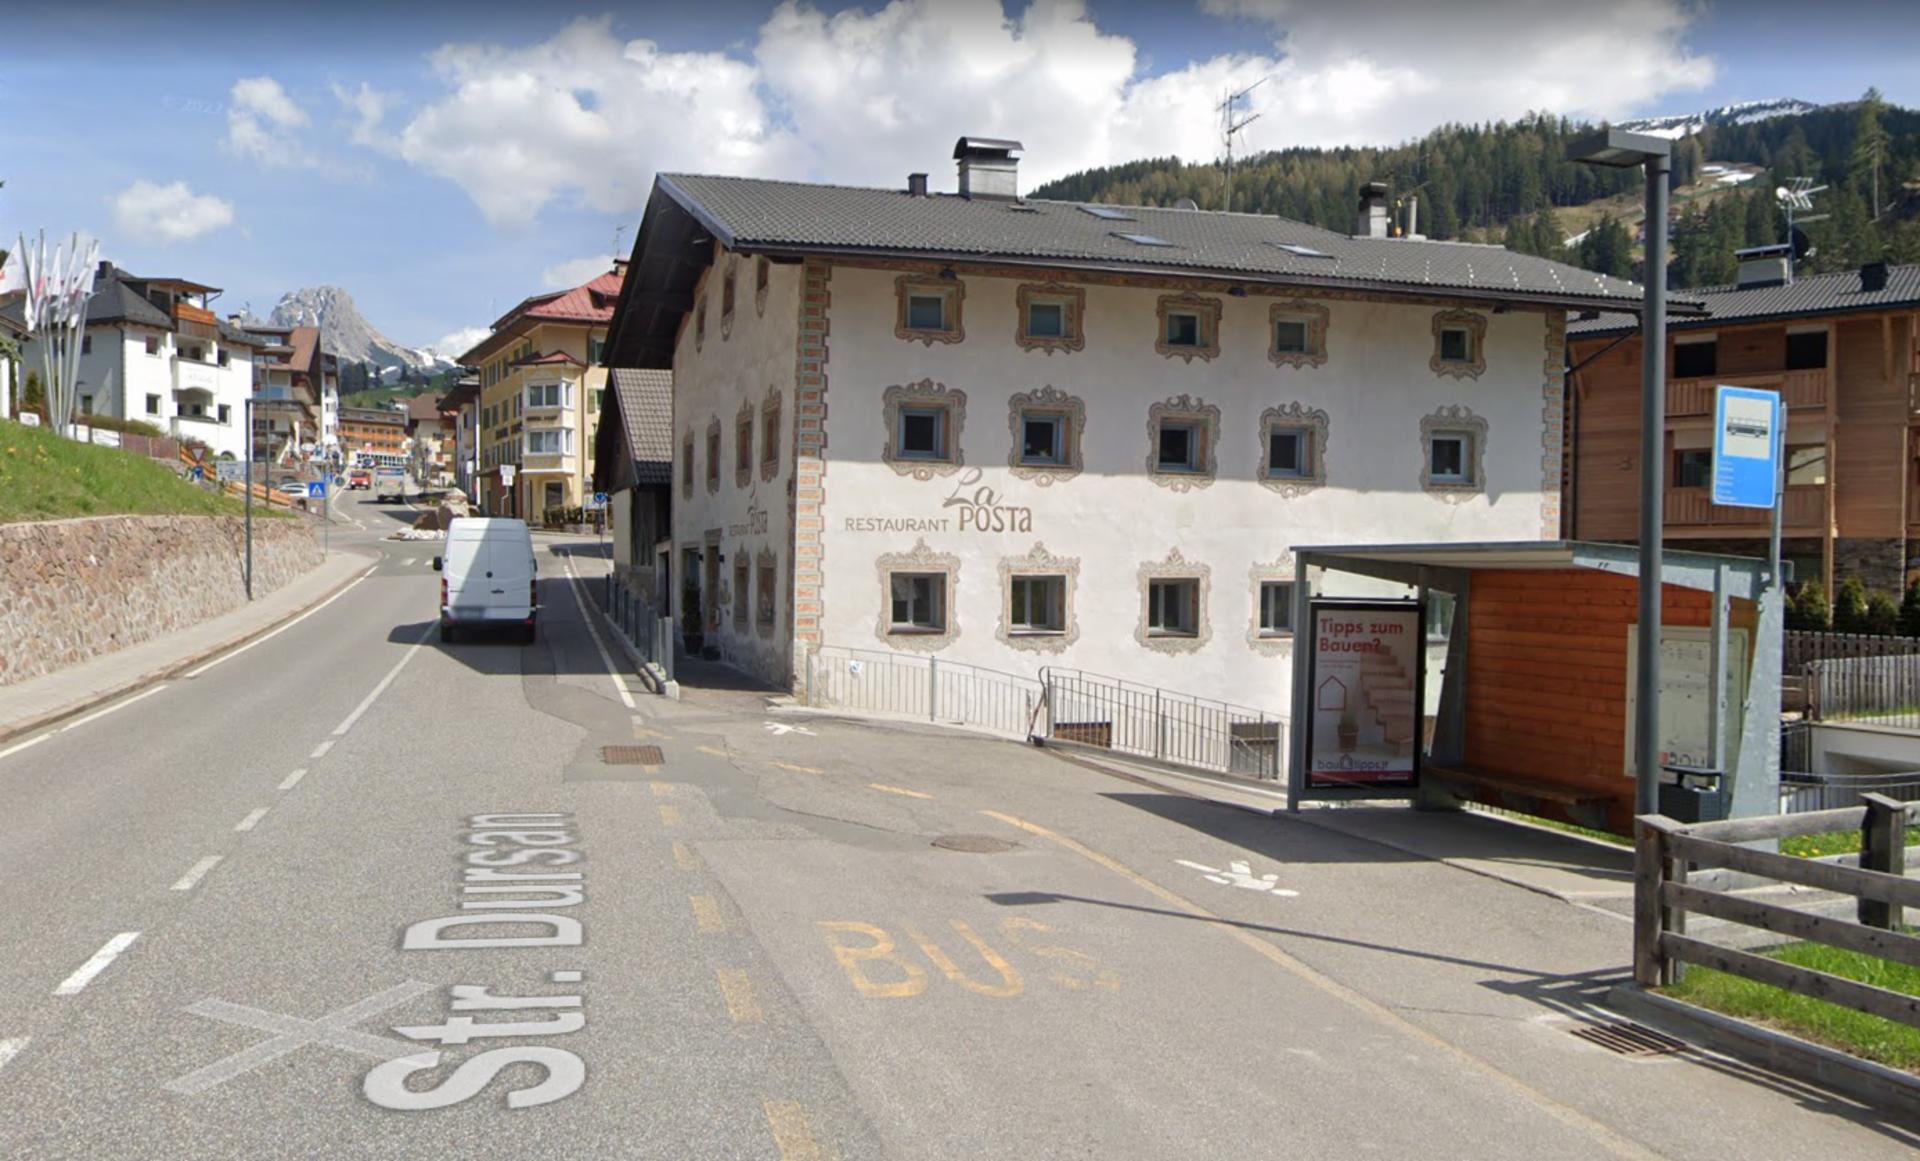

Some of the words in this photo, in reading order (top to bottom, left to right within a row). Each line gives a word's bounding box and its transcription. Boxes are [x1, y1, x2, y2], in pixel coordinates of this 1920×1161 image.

[942, 466, 1004, 509] La
[845, 517, 949, 532] RESTAURANT
[1320, 617, 1364, 638] Tipps
[1370, 622, 1404, 634] zum
[1320, 636, 1382, 653] Bauen?
[817, 916, 1120, 997] BUS
